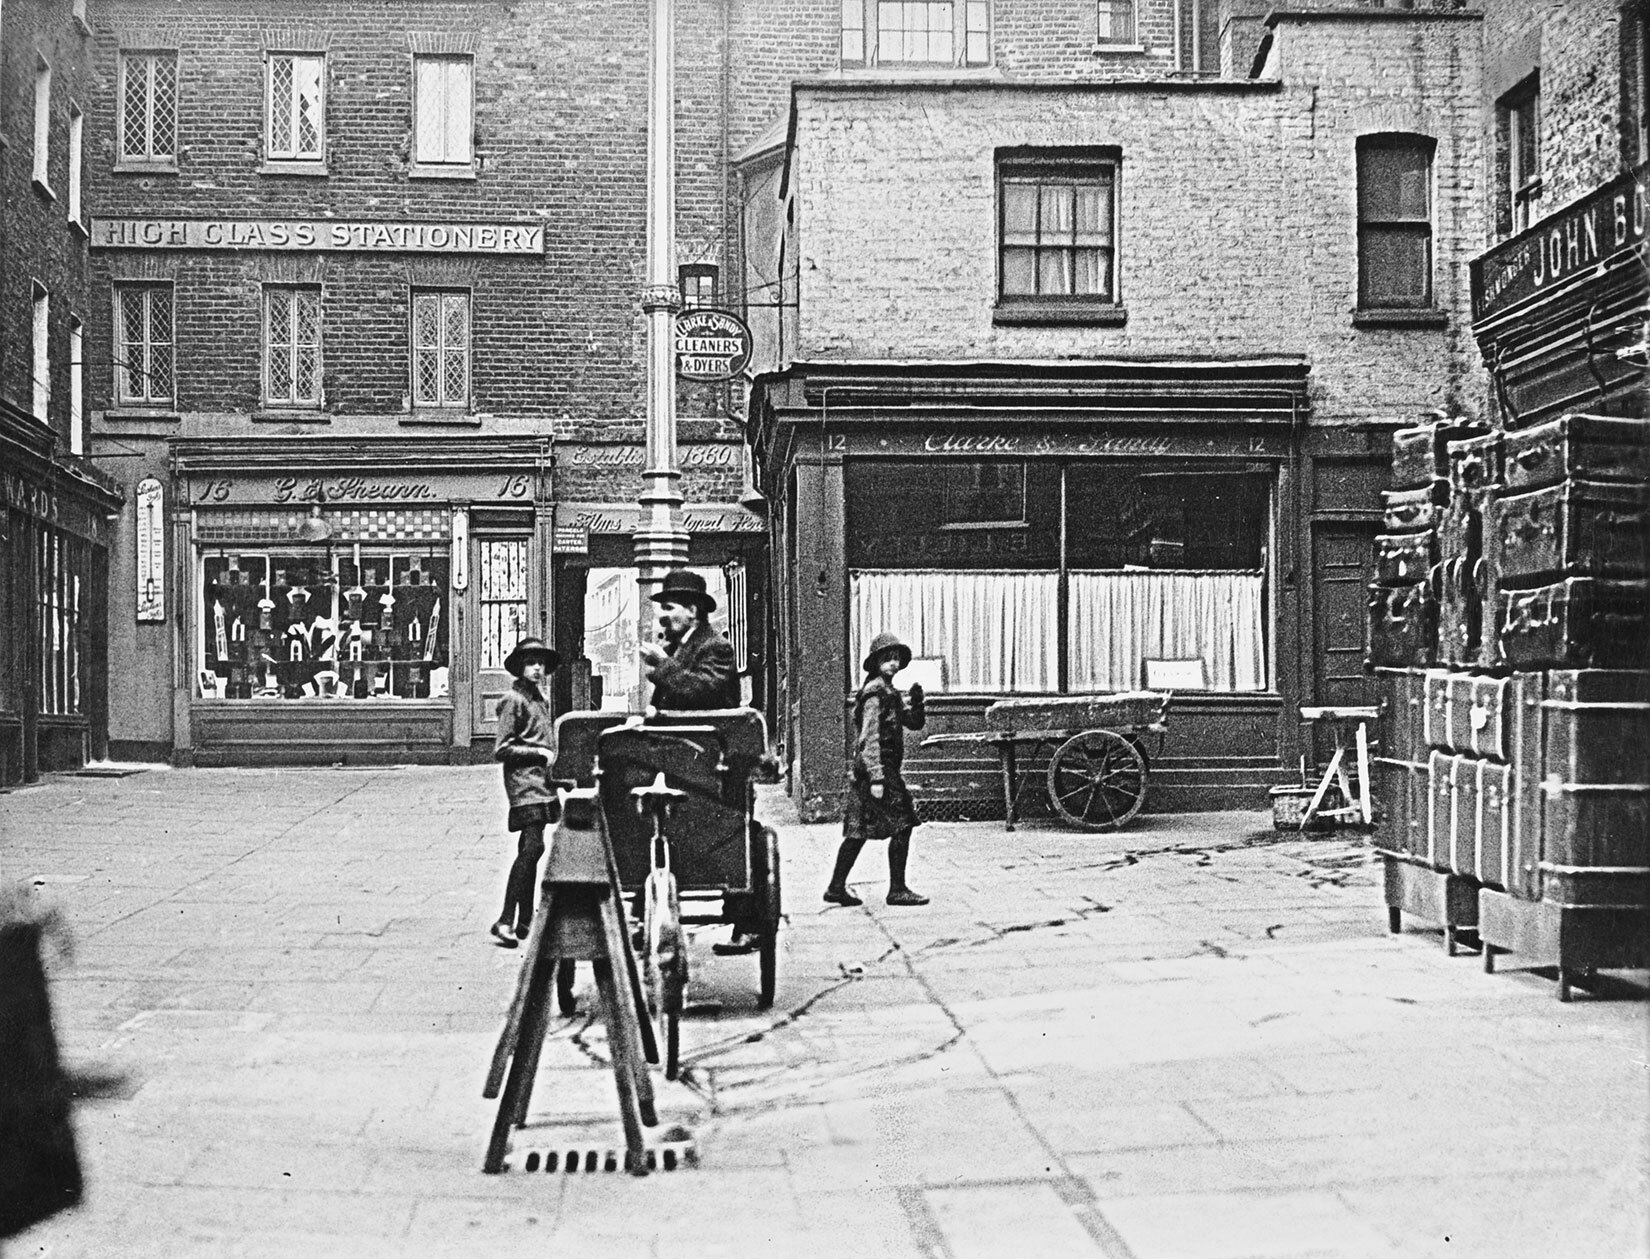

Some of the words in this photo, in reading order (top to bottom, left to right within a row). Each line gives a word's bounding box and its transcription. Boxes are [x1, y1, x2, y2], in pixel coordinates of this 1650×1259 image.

[106, 222, 187, 245] HIGH
[204, 223, 316, 246] CLASS
[331, 225, 540, 249] STATIONERY
[1534, 209, 1598, 286] JOHN
[711, 314, 743, 337] SANDY
[676, 339, 739, 353] CLEANERS
[683, 359, 693, 373] &
[694, 358, 729, 373] DYERS
[828, 434, 846, 450] 12
[924, 432, 1020, 452] Clarke
[1249, 437, 1265, 451] 12
[680, 445, 733, 466] 1860
[199, 480, 233, 501] 16
[497, 475, 530, 499] 16
